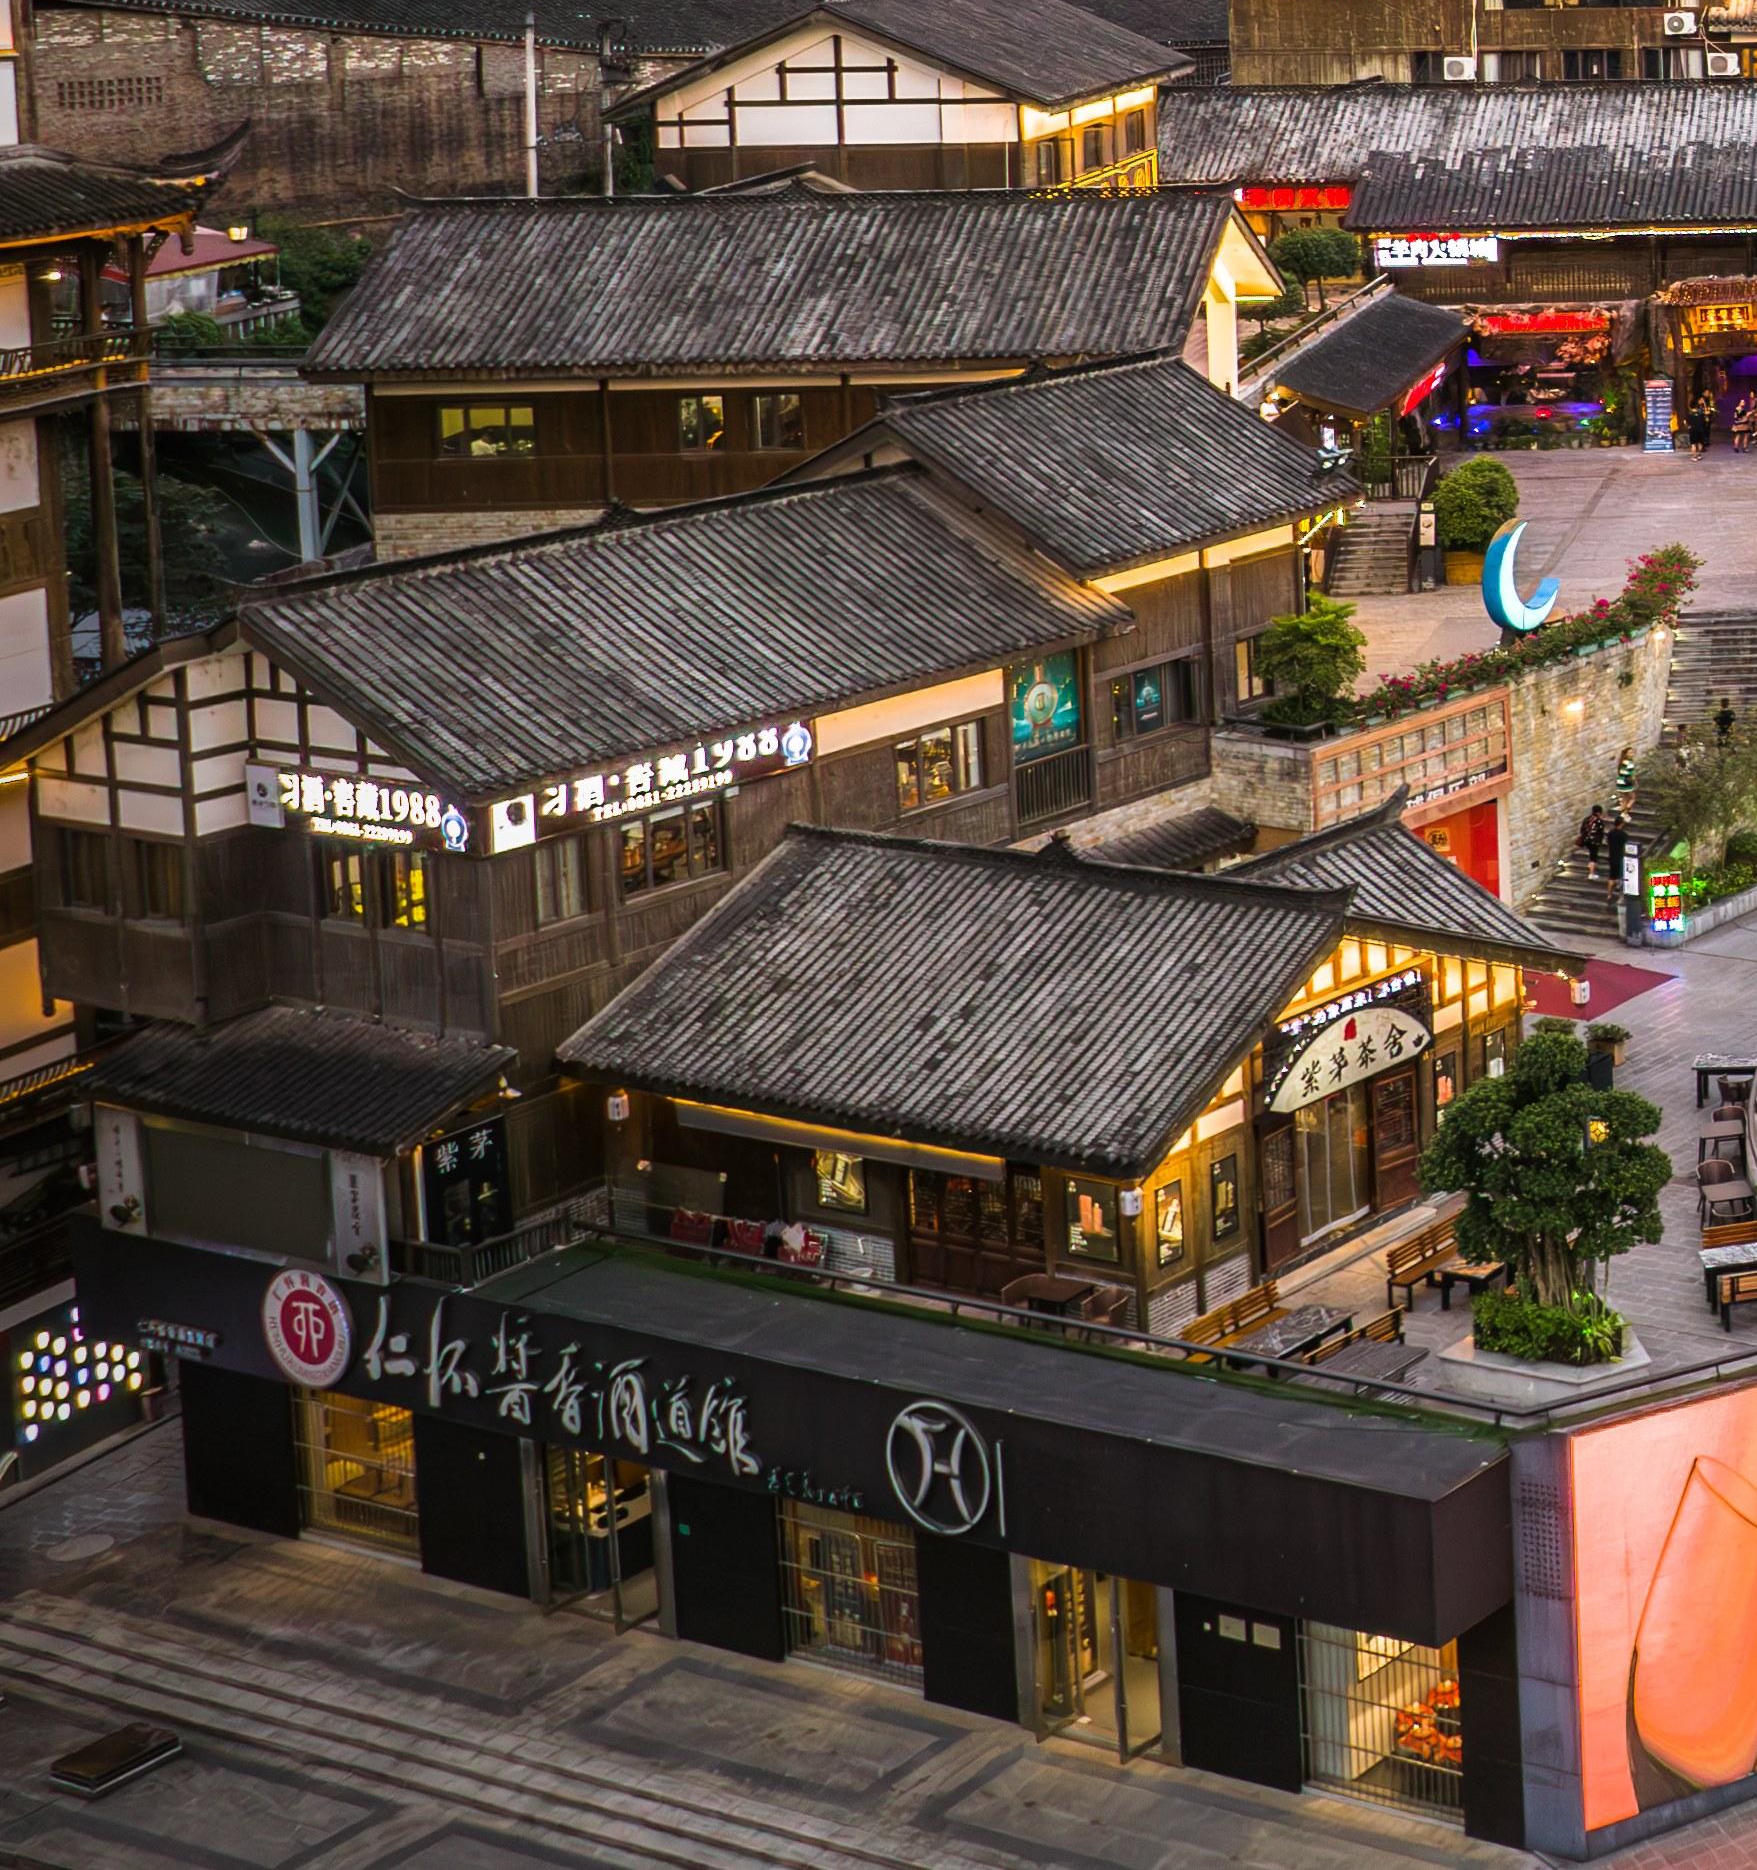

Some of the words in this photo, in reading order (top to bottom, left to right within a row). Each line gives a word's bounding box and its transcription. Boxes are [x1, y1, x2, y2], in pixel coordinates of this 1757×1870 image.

[1300, 1023, 1407, 1098] 紫茅茶舍
[435, 1128, 494, 1175] 紫茅
